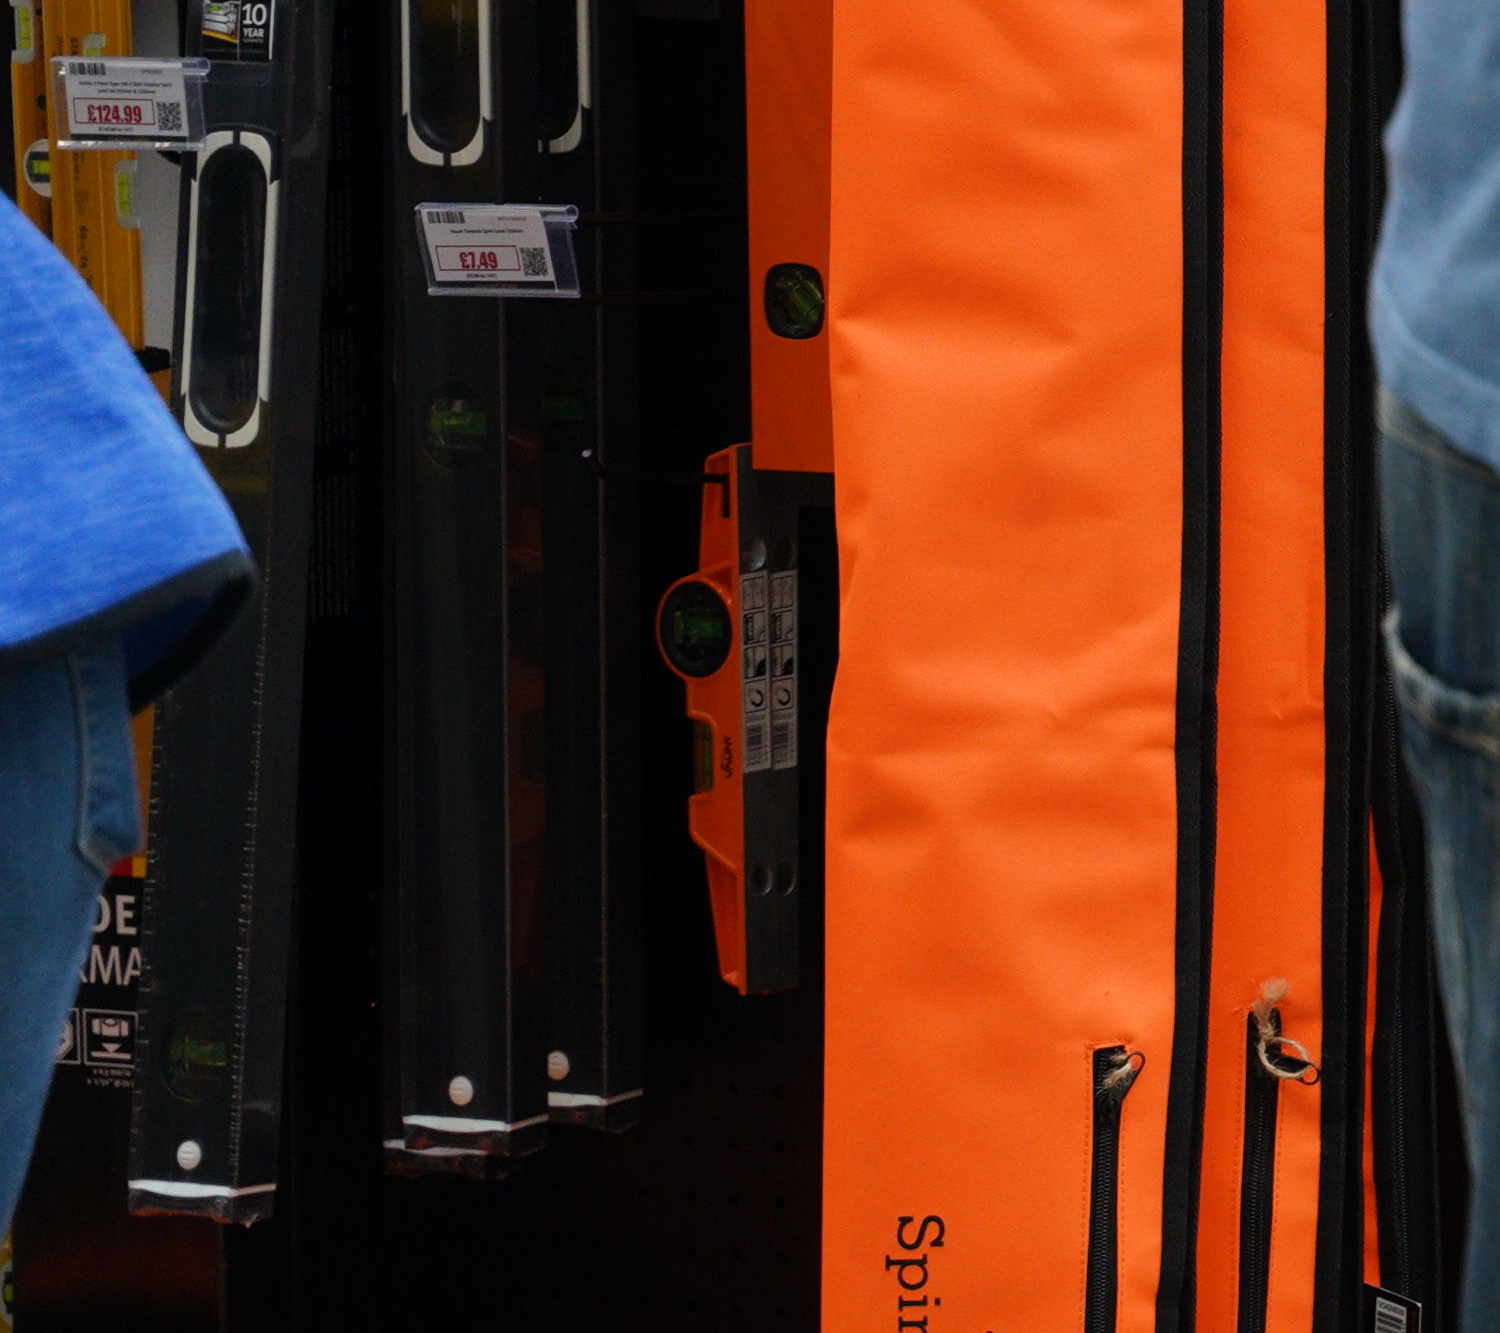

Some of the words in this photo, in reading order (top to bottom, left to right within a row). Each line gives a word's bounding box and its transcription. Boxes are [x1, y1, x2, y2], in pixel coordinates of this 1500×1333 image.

[242, 2, 268, 26] 10
[243, 27, 265, 38] YEAR
[87, 104, 142, 124] £124.99
[459, 251, 499, 269] £7.49
